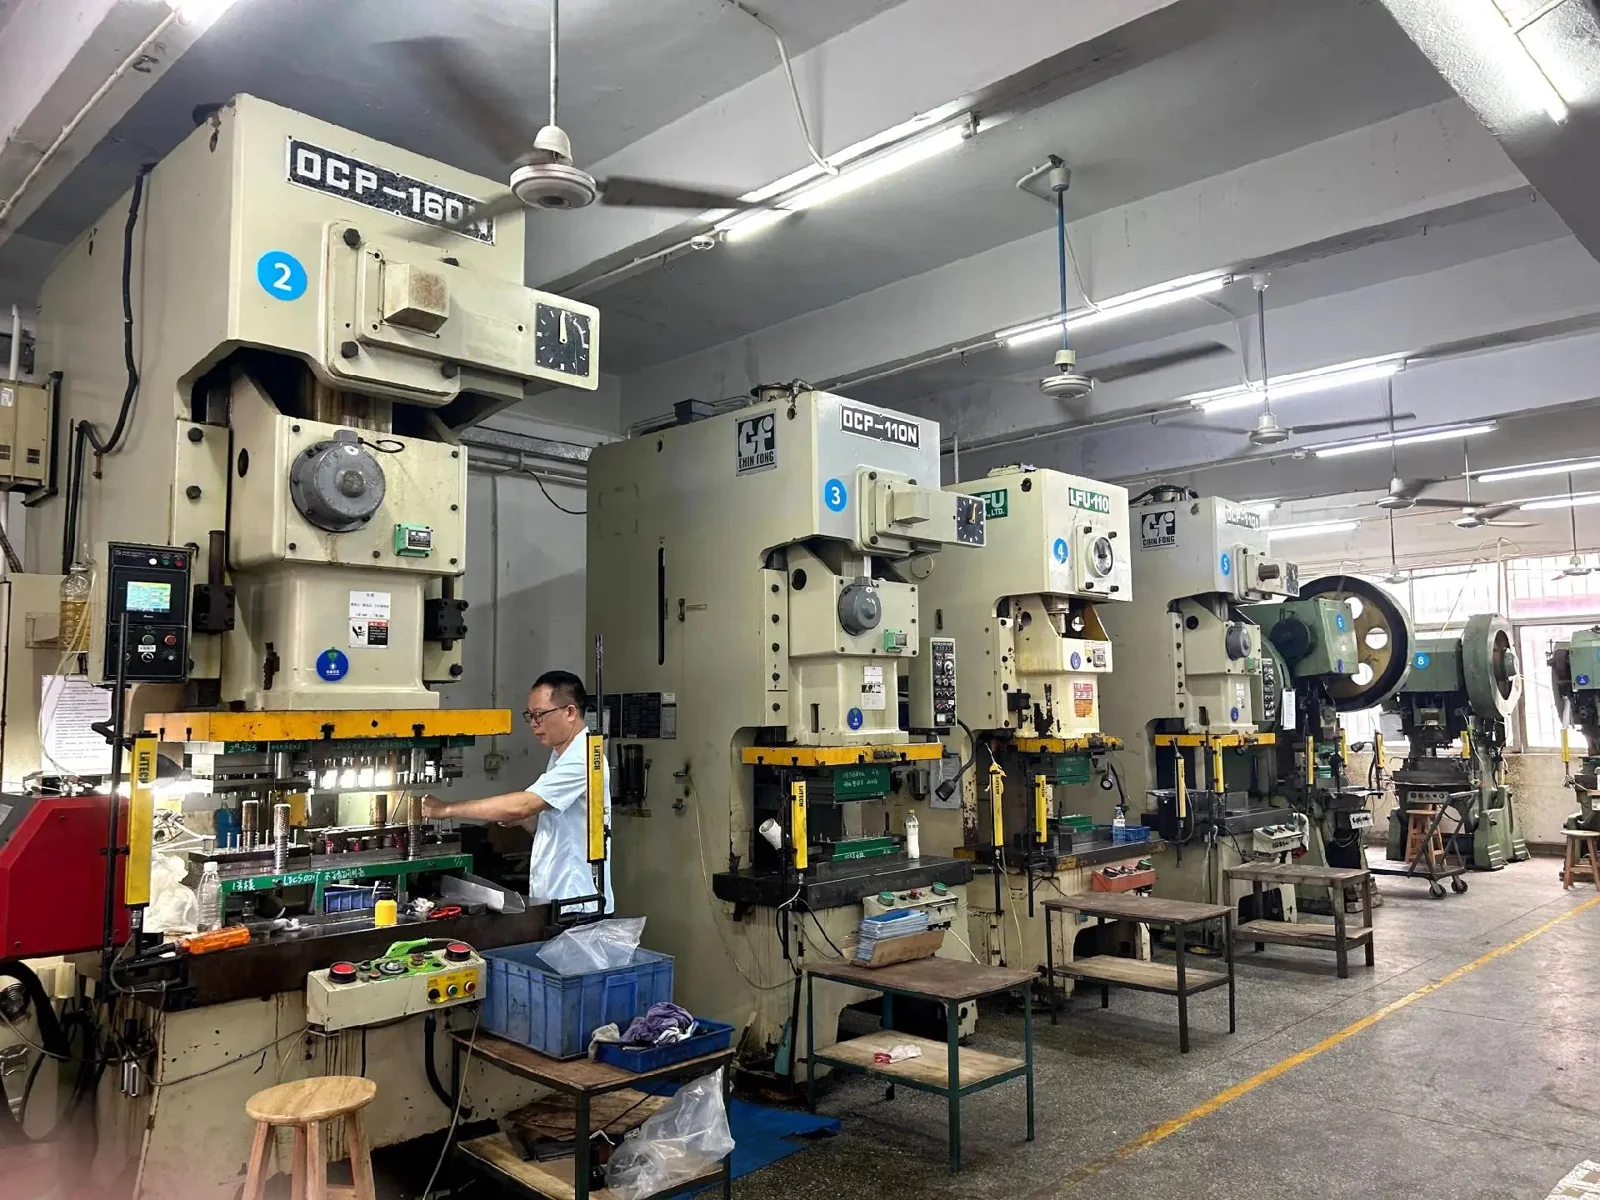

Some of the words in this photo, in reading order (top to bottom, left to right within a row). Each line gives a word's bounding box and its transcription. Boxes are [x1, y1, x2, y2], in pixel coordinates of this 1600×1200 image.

[273, 262, 292, 292] 2
[842, 409, 918, 444] OCP-110N
[738, 456, 755, 469] CHIN
[756, 450, 774, 465] FONG
[831, 486, 841, 505] 3
[1158, 535, 1175, 545] FONG
[1057, 543, 1065, 559] 4
